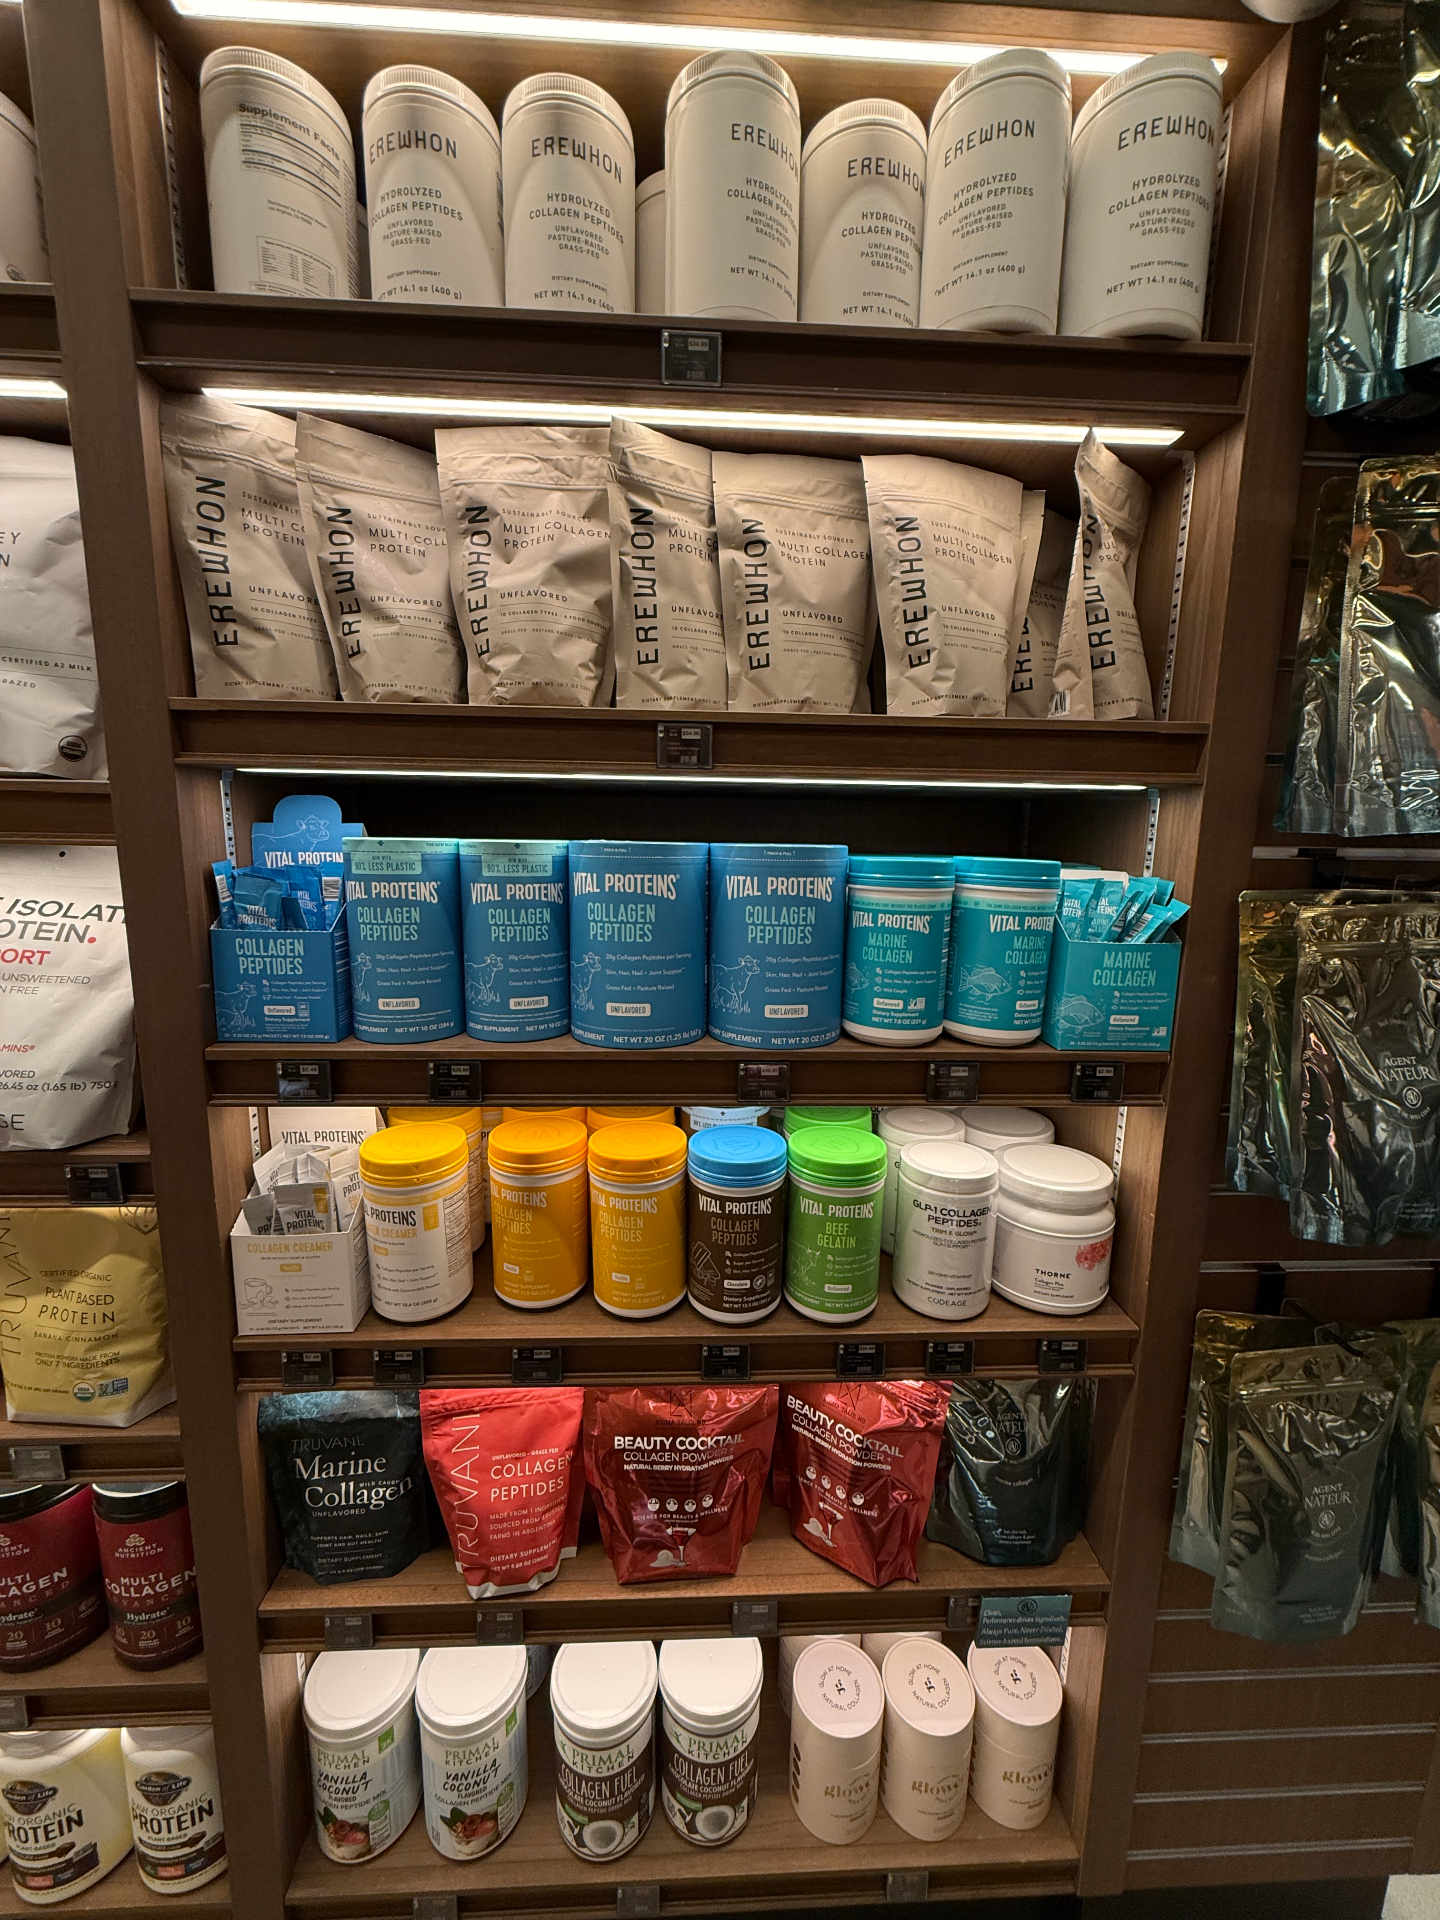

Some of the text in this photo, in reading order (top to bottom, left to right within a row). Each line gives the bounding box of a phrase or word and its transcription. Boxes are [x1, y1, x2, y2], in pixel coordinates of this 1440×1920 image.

[239, 103, 310, 136] Supplement
[314, 132, 340, 161] Facts
[1118, 115, 1214, 151] EREWHON
[369, 130, 457, 165] EREWHON
[731, 123, 799, 183] EREWHON
[944, 120, 1035, 168] EREWHON
[531, 137, 623, 184] EREWHON
[848, 157, 925, 198] EREWHON
[954, 172, 1016, 200] HYDROLYZED
[1132, 174, 1200, 190] HYDROLYZED
[380, 187, 441, 203] HYDROLYZED
[727, 189, 773, 208] COLLAGEN
[1108, 189, 1168, 214] COLLAGEN
[372, 202, 463, 227] COLLAGEN PEPTIDES
[547, 193, 611, 218] HYDROLYZED
[939, 186, 1034, 225] COLLAGEN PEPTIDES
[388, 220, 433, 229] UNFLAVORED
[841, 226, 892, 237] COLLAGEN
[241, 507, 284, 527] MULTI
[243, 524, 305, 546] PROTEIN
[369, 528, 408, 540] MULTI
[503, 522, 611, 538] MULTI COLLAGEN
[668, 529, 702, 543] MULTI
[370, 544, 426, 557] PROTEIN
[504, 534, 555, 549] PROTEIN
[196, 476, 239, 647] EREWHON
[669, 544, 713, 563] PROTEIN
[935, 547, 976, 565] PROTEIN
[326, 506, 362, 658] EREWHON
[465, 505, 491, 658] EREWHON
[629, 507, 658, 665] EREWHON
[500, 590, 568, 602] UNFLAVORED
[742, 518, 769, 670] EREWHON
[895, 516, 930, 669] EREWHON
[1083, 514, 1116, 670] EREWHON
[370, 596, 443, 607] UNFLAVORED
[783, 610, 843, 623] UNFLAVORED
[941, 605, 995, 620] UNFLAVORED
[2, 656, 50, 667] CERTIFIED
[69, 664, 92, 672] MILK
[265, 852, 295, 868] VITAL
[471, 883, 501, 904] VITAL
[573, 872, 600, 897] VITAL
[726, 876, 761, 900] VITAL
[7, 899, 128, 924] ISOLAT
[358, 907, 420, 923] COLLAGEN
[488, 908, 550, 924] COLLAGEN
[588, 903, 655, 922] COLLAGEN
[746, 906, 815, 924] COLLAGEN
[990, 914, 1020, 932] VITAL
[360, 925, 418, 941] PEPTIDES
[491, 926, 549, 941] PEPTIDES
[590, 923, 652, 942] PEPTIDES
[748, 926, 812, 944] PEPTIDES
[869, 933, 907, 948] MARINE
[236, 938, 304, 956] COLLAGEN
[863, 947, 912, 963] COLLAGEN
[239, 958, 303, 974] PEPTIDES
[1103, 952, 1152, 968] MARINE
[2, 973, 91, 985] UNSWEETENED
[1093, 970, 1156, 986] COLLAGEN
[10, 986, 39, 995] FREE
[770, 1007, 804, 1015] UNFLAVORED
[1385, 1056, 1417, 1066] AGENT
[1379, 1067, 1434, 1081] NATEUR
[282, 1131, 311, 1144] VITAL
[502, 1188, 547, 1207] PROTEINS
[610, 1197, 657, 1213] PROTEINS
[699, 1193, 722, 1213] VITAL
[800, 1196, 824, 1216] VITAL
[295, 1211, 316, 1219] VITAL
[913, 1199, 992, 1218] GLP-1 COLLAGEN
[287, 1219, 325, 1232] PROTEINS
[371, 1210, 416, 1226] PROTEINS
[600, 1211, 644, 1228] COLLAGEN
[711, 1217, 759, 1232] COLLAGEN
[826, 1222, 849, 1235] BEEF
[247, 1242, 333, 1253] COLLAGEN CREAMER
[713, 1232, 757, 1246] PEPTIDES
[818, 1234, 856, 1248] GELATIN
[81, 1271, 112, 1281] ORGANIC
[1035, 1269, 1072, 1279] THORNE
[45, 1287, 114, 1305] PLANT BASED
[928, 1296, 967, 1306] CODEAGE
[39, 1305, 114, 1325] PROTEIN
[787, 1395, 903, 1458] BEAUTY COCKTAIL
[615, 1434, 745, 1450] BEAUTY COCKTAIL
[792, 1413, 884, 1461] COLLAGEN POWDER
[492, 1452, 526, 1461] UNFLAVORED
[624, 1449, 728, 1462] COLLAGEN POWDER
[294, 1451, 386, 1480] Marine
[491, 1452, 573, 1479] COLLAGEN
[305, 1477, 412, 1509] Collagen
[451, 1413, 480, 1567] TRUVANI
[491, 1477, 564, 1502] PEPTIDES
[1312, 1483, 1342, 1493] AGENT
[1303, 1492, 1350, 1506] NATEUR
[312, 1509, 366, 1517] UNFLAVORED
[115, 1547, 163, 1558] NUTRITION
[490, 1538, 557, 1561] DIETARY SUPPLEMENT
[105, 1566, 196, 1597] COLLAGEN
[121, 1573, 163, 1585] MULTI
[45, 1618, 61, 1630] 10
[912, 1690, 937, 1709] NATURAL
[445, 1737, 499, 1760] PRIMAL
[688, 1729, 748, 1753] PRIMAL
[445, 1745, 499, 1765] KITCHEN
[572, 1744, 633, 1766] PRIMAL
[572, 1753, 634, 1773] KITCHEN
[446, 1758, 497, 1781] VANILLA
[674, 1751, 748, 1785] COLLAGEN FUEL
[443, 1763, 501, 1792] COCONUT
[561, 1764, 638, 1798] COLLAGEN FUEL
[38, 1789, 53, 1798] Life
[317, 1778, 372, 1796] COCONUT
[152, 1793, 208, 1816] ORGANIC
[18, 1803, 77, 1825] ORGANIC
[132, 1799, 214, 1834] PROTEIN
